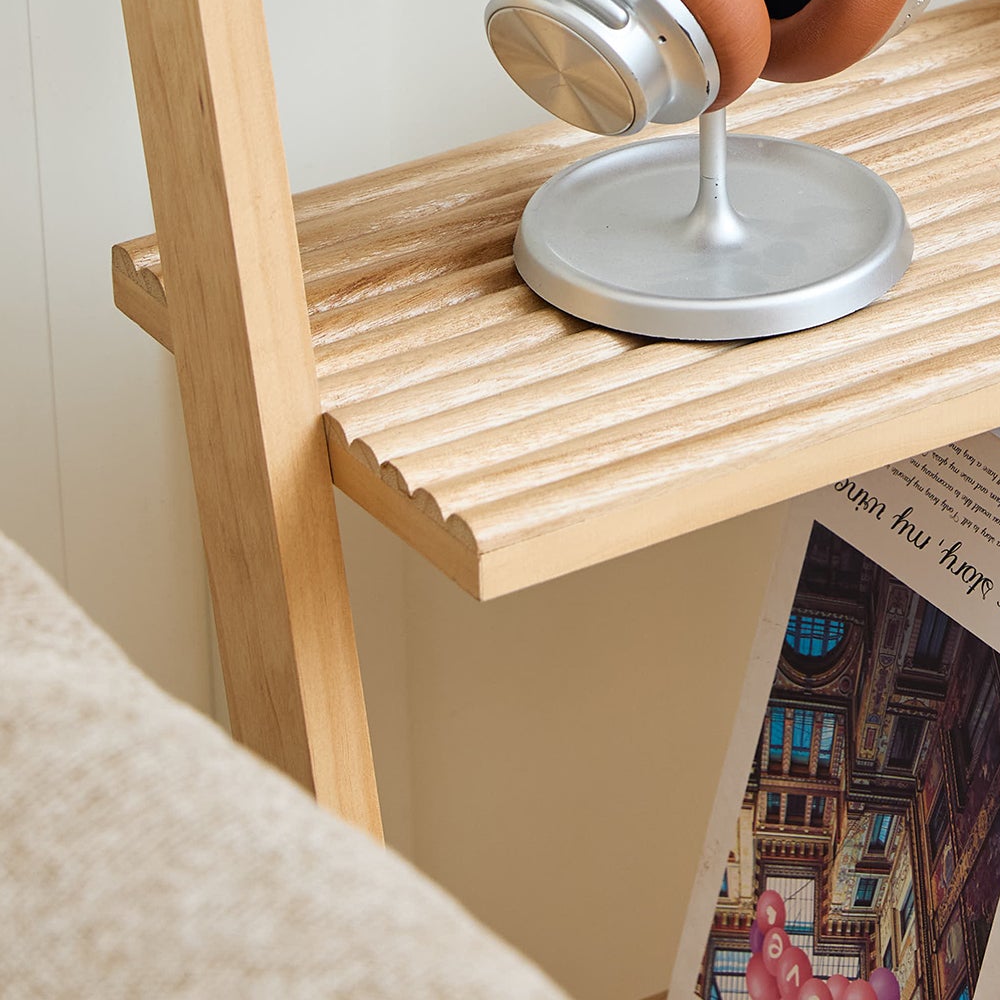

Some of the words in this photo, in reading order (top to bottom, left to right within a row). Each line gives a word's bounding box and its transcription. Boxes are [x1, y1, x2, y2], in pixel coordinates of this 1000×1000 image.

[963, 449, 976, 466] long
[949, 462, 960, 474] my
[983, 466, 998, 481] have
[913, 480, 924, 492] my
[973, 483, 988, 494] and
[834, 478, 887, 521] wine
[890, 506, 932, 551] my
